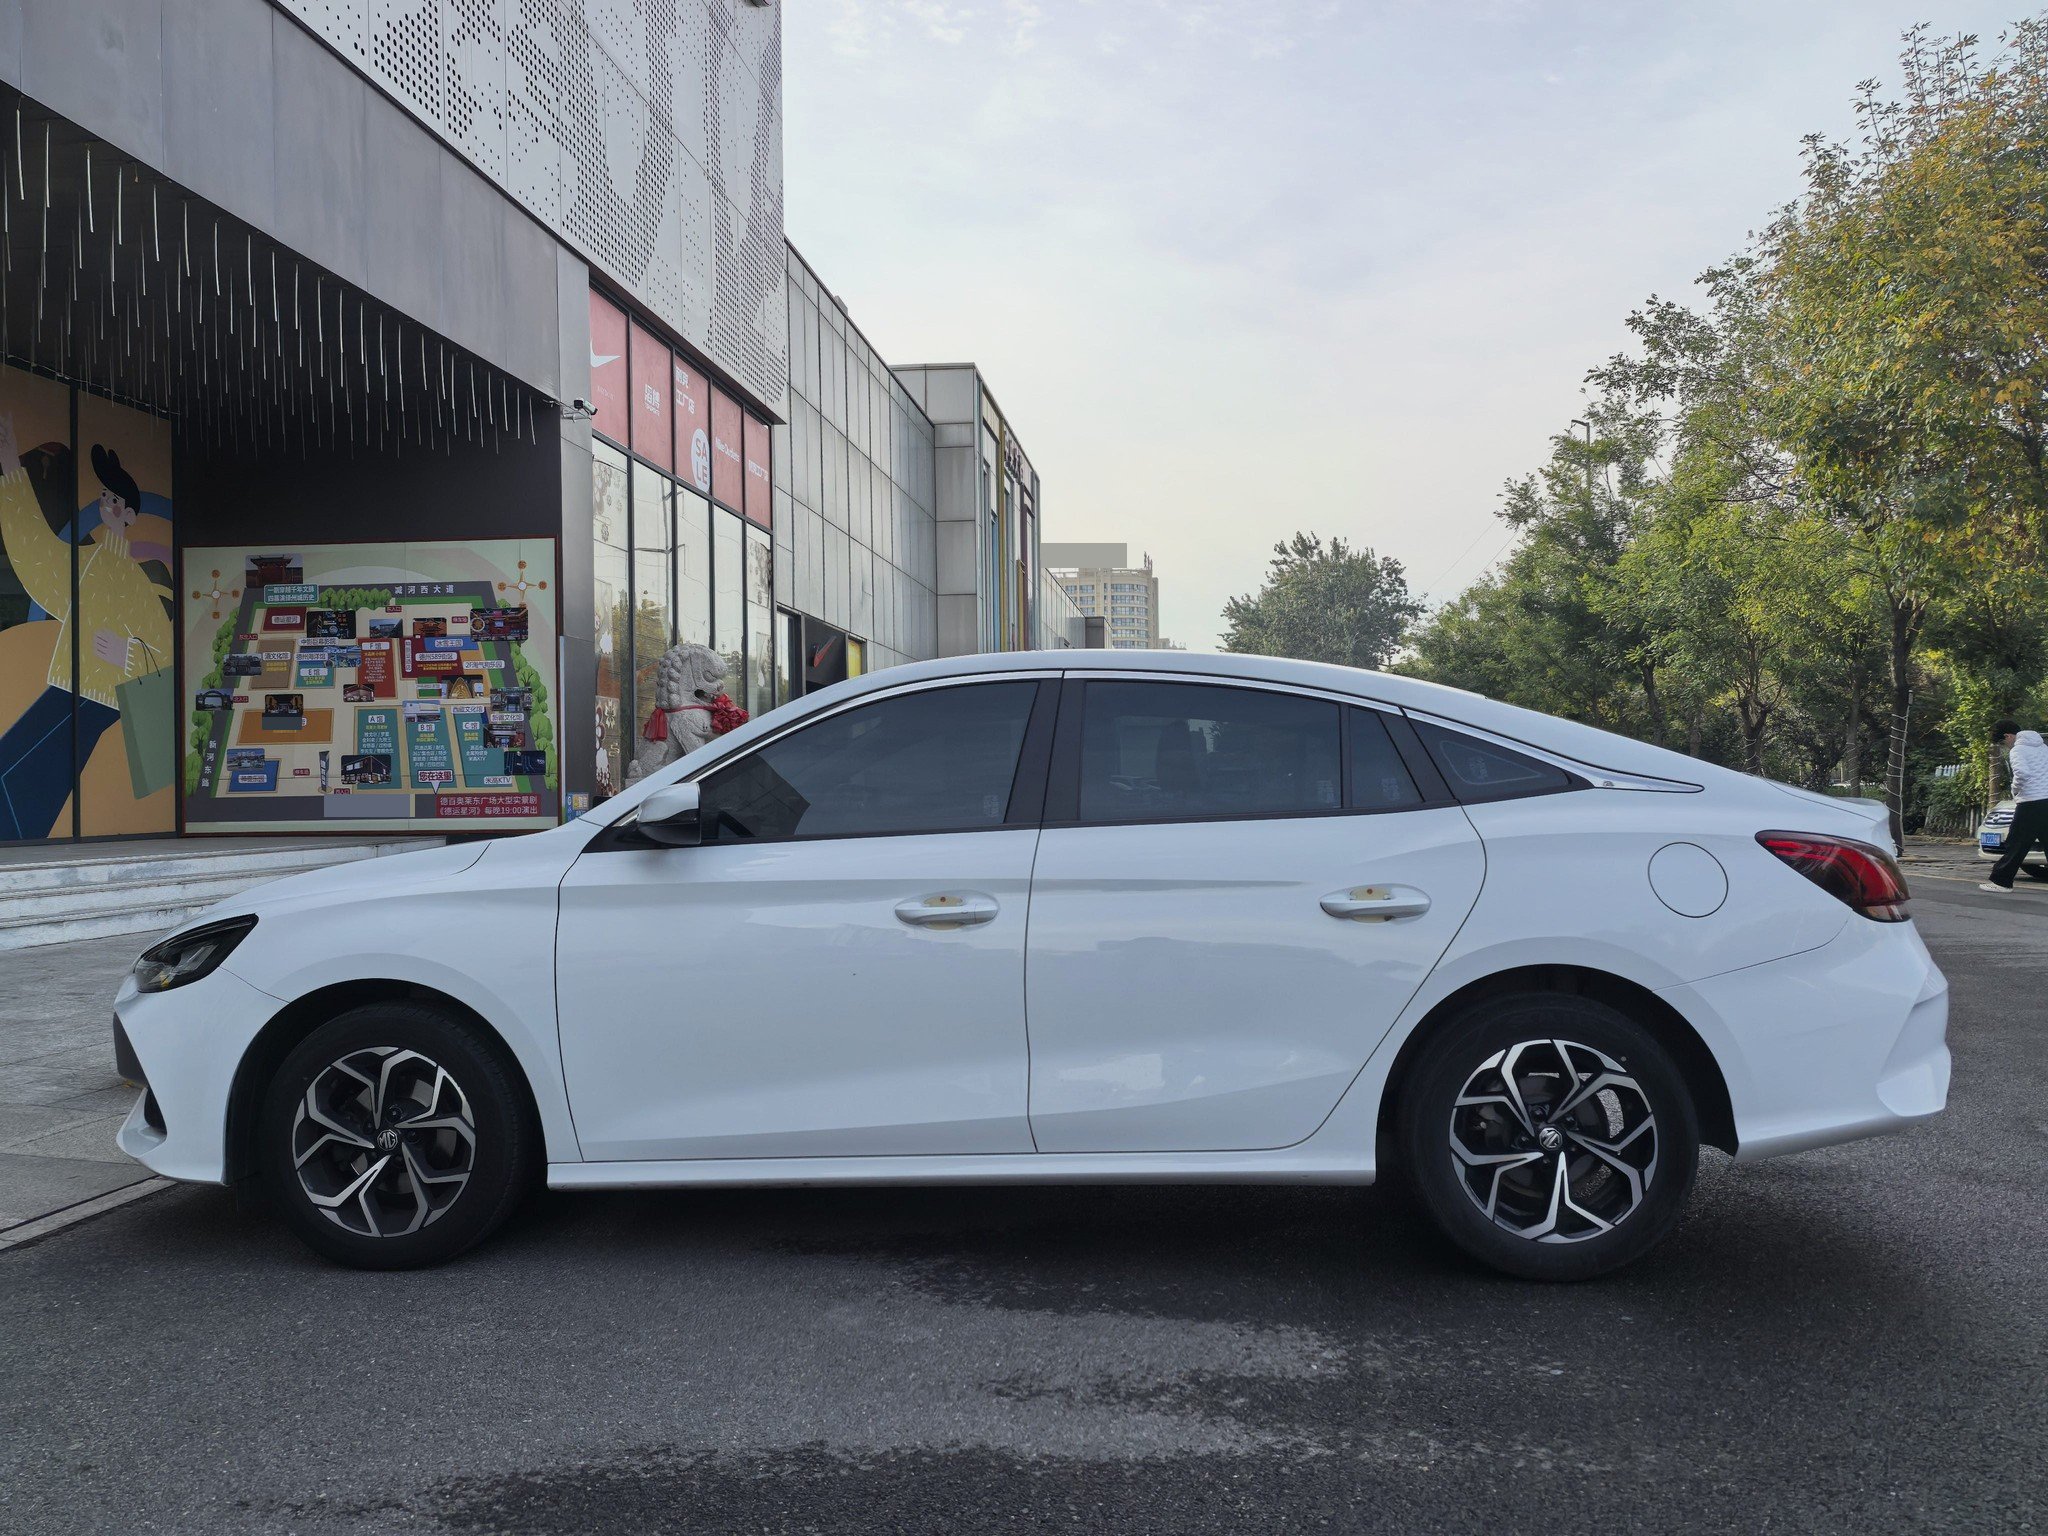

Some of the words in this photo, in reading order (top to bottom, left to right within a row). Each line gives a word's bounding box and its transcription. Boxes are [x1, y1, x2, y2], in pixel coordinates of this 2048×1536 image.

[695, 437, 708, 462] SA
[394, 584, 455, 594] 减河西大道
[420, 771, 452, 781] 您在这里
[440, 796, 537, 805] 德百奥莱东广场大型实景剧
[379, 1131, 396, 1149] MG
